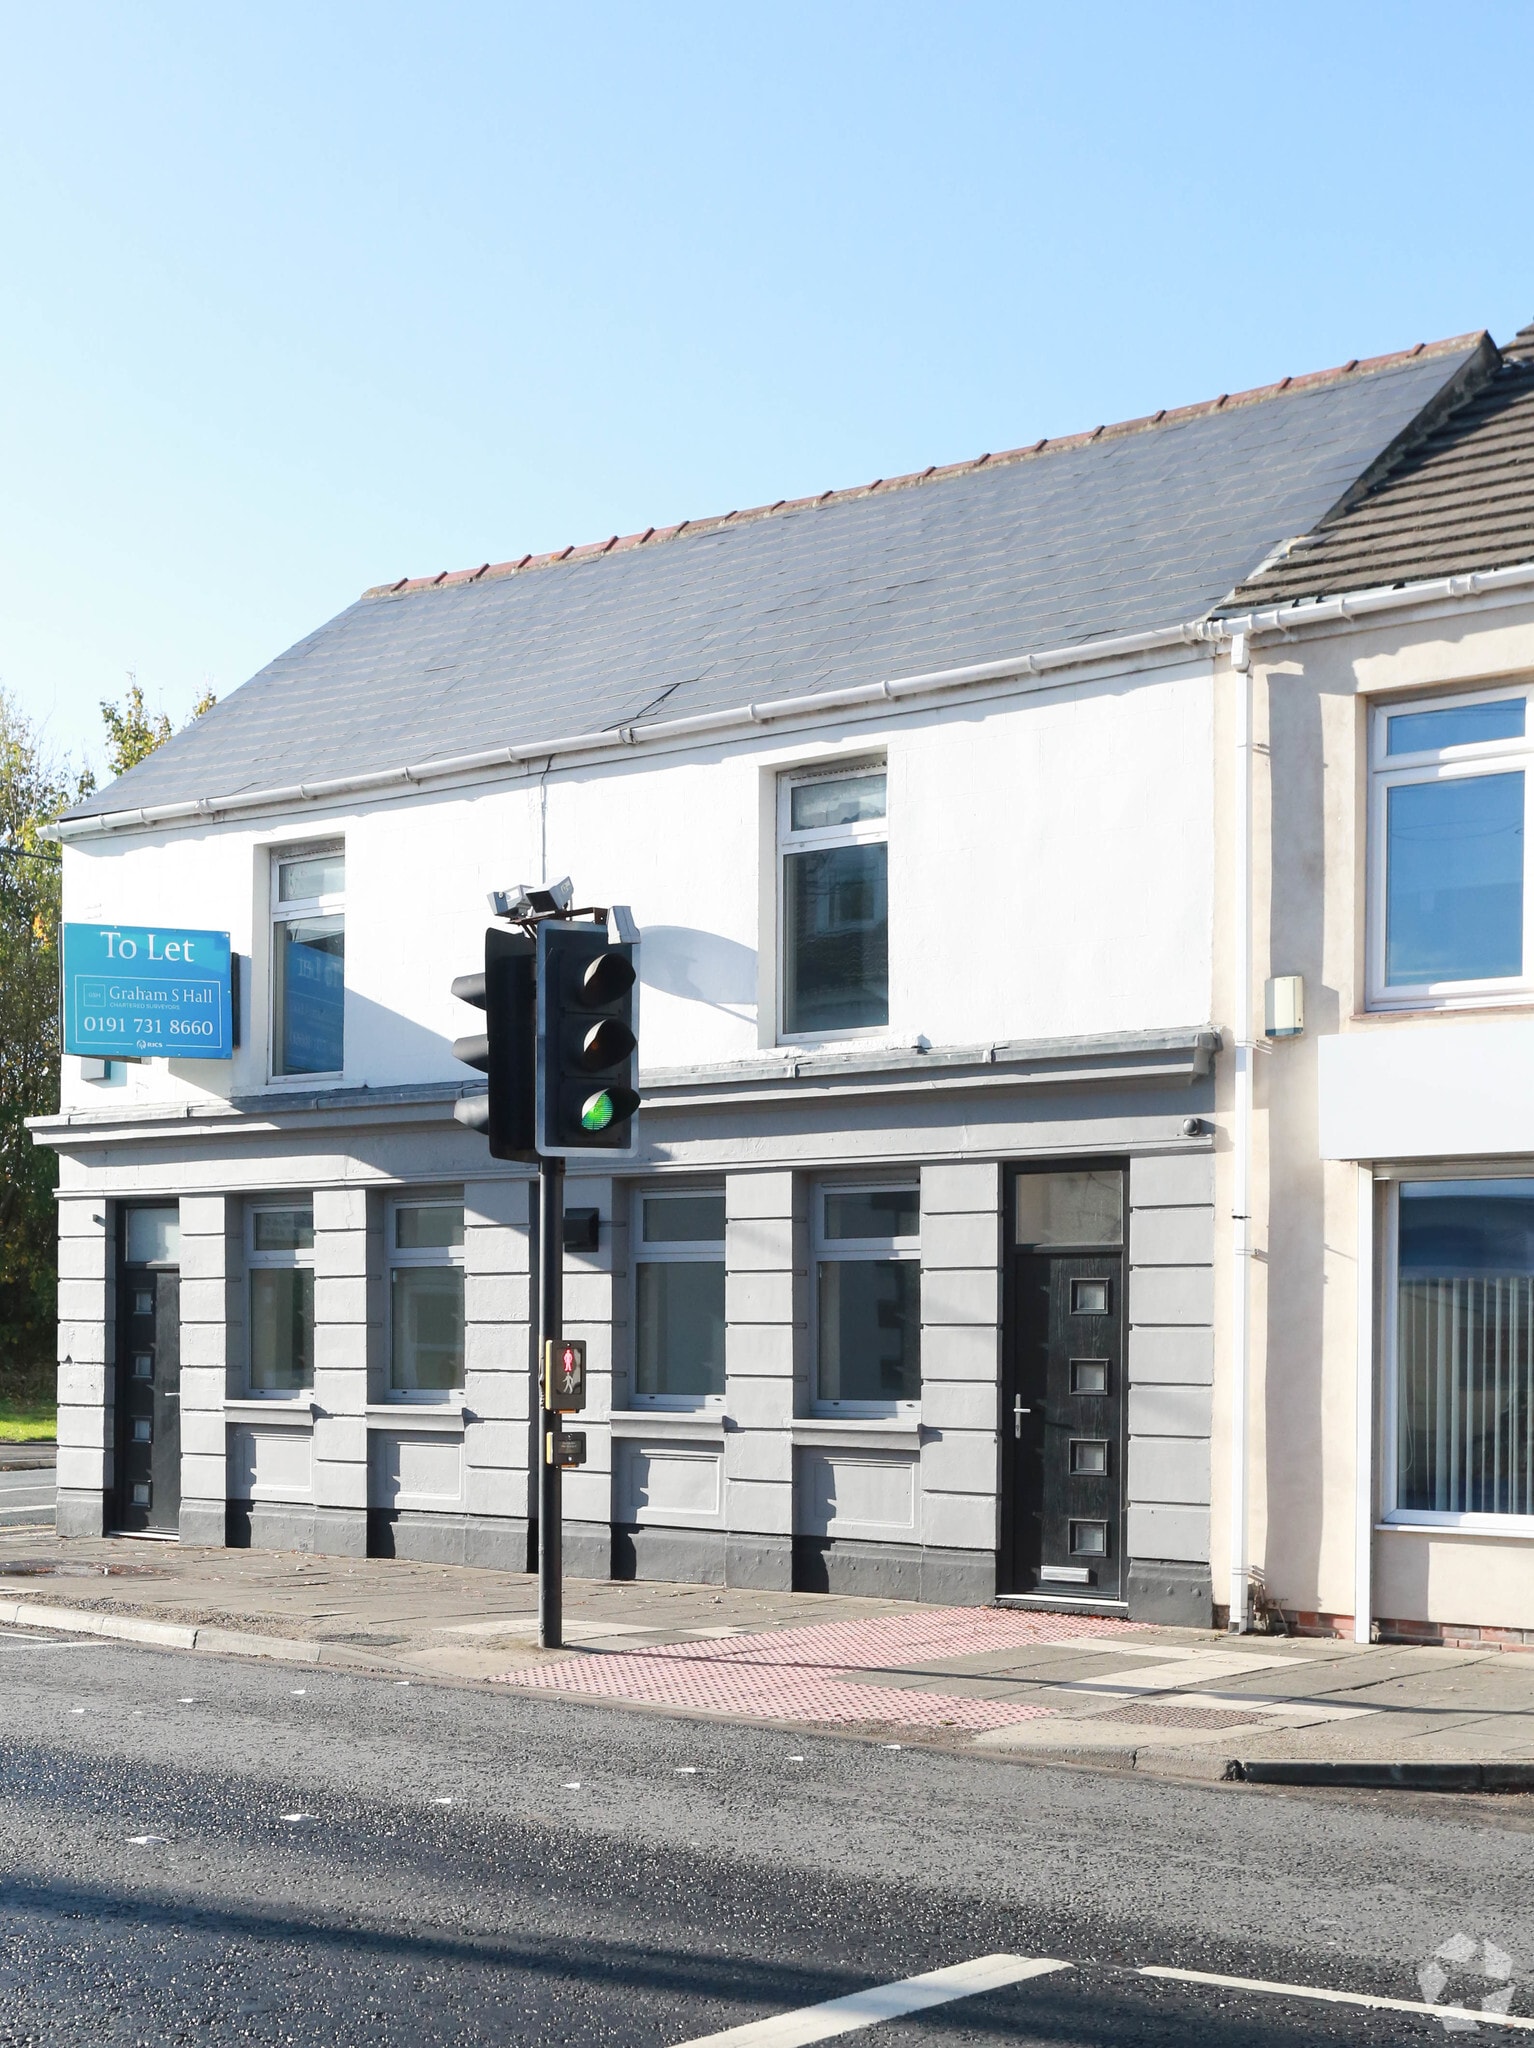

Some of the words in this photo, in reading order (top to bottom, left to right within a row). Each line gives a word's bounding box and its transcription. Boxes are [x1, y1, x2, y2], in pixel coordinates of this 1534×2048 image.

[100, 931, 138, 959] To
[147, 933, 195, 962] Let
[109, 986, 168, 1002] Graham
[171, 988, 179, 1002] S
[183, 989, 213, 1004] Hall
[83, 1016, 126, 1032] 0191
[133, 1018, 162, 1034] 731
[169, 1020, 214, 1036] 8660
